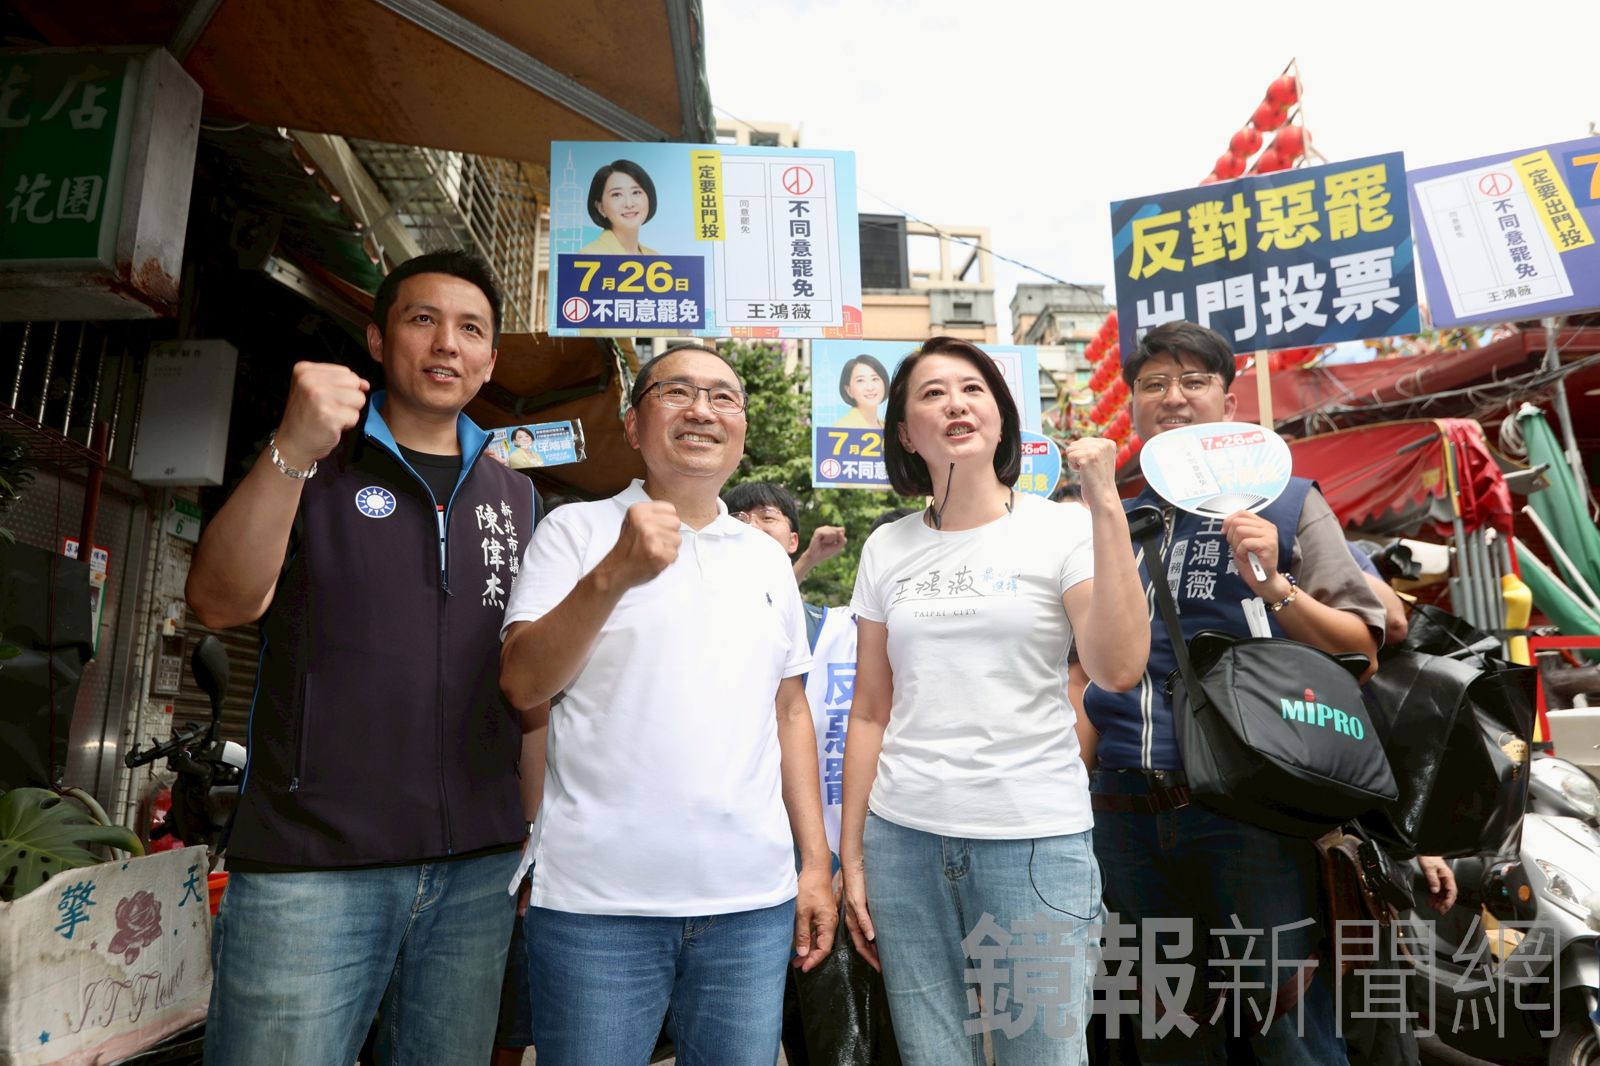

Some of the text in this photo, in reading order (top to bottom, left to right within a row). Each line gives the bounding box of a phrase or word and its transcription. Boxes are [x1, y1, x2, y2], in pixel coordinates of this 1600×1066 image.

[697, 155, 720, 239] 一定要出門投
[1521, 157, 1584, 247] 一定要出門投
[739, 200, 751, 234] 同意罷免
[1127, 163, 1395, 281] 反對惡罷
[788, 200, 815, 298] 不同意罷免
[1492, 198, 1538, 280] 不同意罷免
[573, 260, 689, 294] 7月26日
[1487, 285, 1533, 303] 王鴻薇
[592, 298, 700, 324] 不同意罷免
[747, 303, 812, 320] 王鴻薇
[828, 431, 886, 457] 7月2
[475, 503, 506, 610] 陳偉杰
[953, 607, 978, 616] CITY
